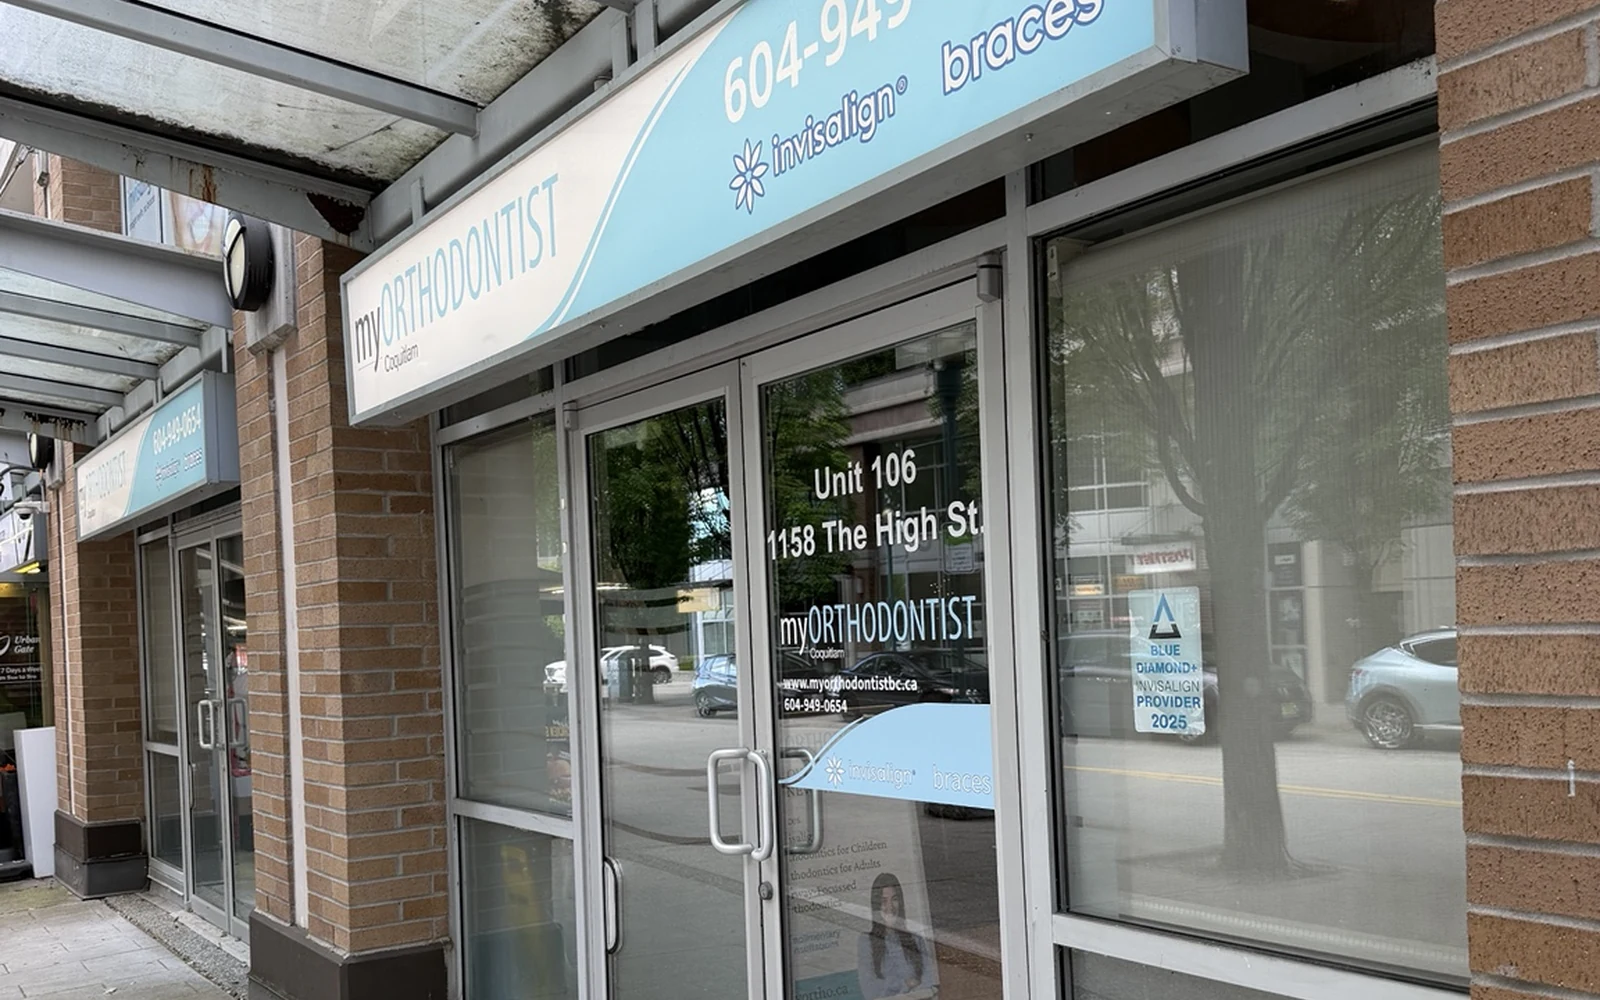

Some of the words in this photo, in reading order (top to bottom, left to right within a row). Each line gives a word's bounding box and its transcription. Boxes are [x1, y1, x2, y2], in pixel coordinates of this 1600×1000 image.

[354, 173, 558, 373] myORTHODONTIST
[383, 344, 419, 373] Coquitlam
[814, 461, 864, 500] Unit
[871, 449, 917, 489] 106
[767, 524, 815, 560] 1158
[822, 519, 867, 553] The
[875, 506, 938, 553] High
[947, 499, 984, 538] St.
[780, 595, 976, 655] myORTHODONTIST
[14, 645, 35, 653] Gate
[810, 646, 846, 661] Coquitlam
[1150, 644, 1181, 656] BLUE
[783, 676, 918, 692] www.myorthodontistbc.ca
[1136, 680, 1200, 693] INVISALIGN
[784, 697, 847, 713] 604-949-0654
[1136, 695, 1201, 708] PROVIDER
[1151, 713, 1187, 729] 2025
[932, 763, 992, 795] braces
[837, 844, 849, 856] for
[851, 840, 888, 854] Children
[839, 862, 852, 874] for
[854, 859, 882, 871] Adults
